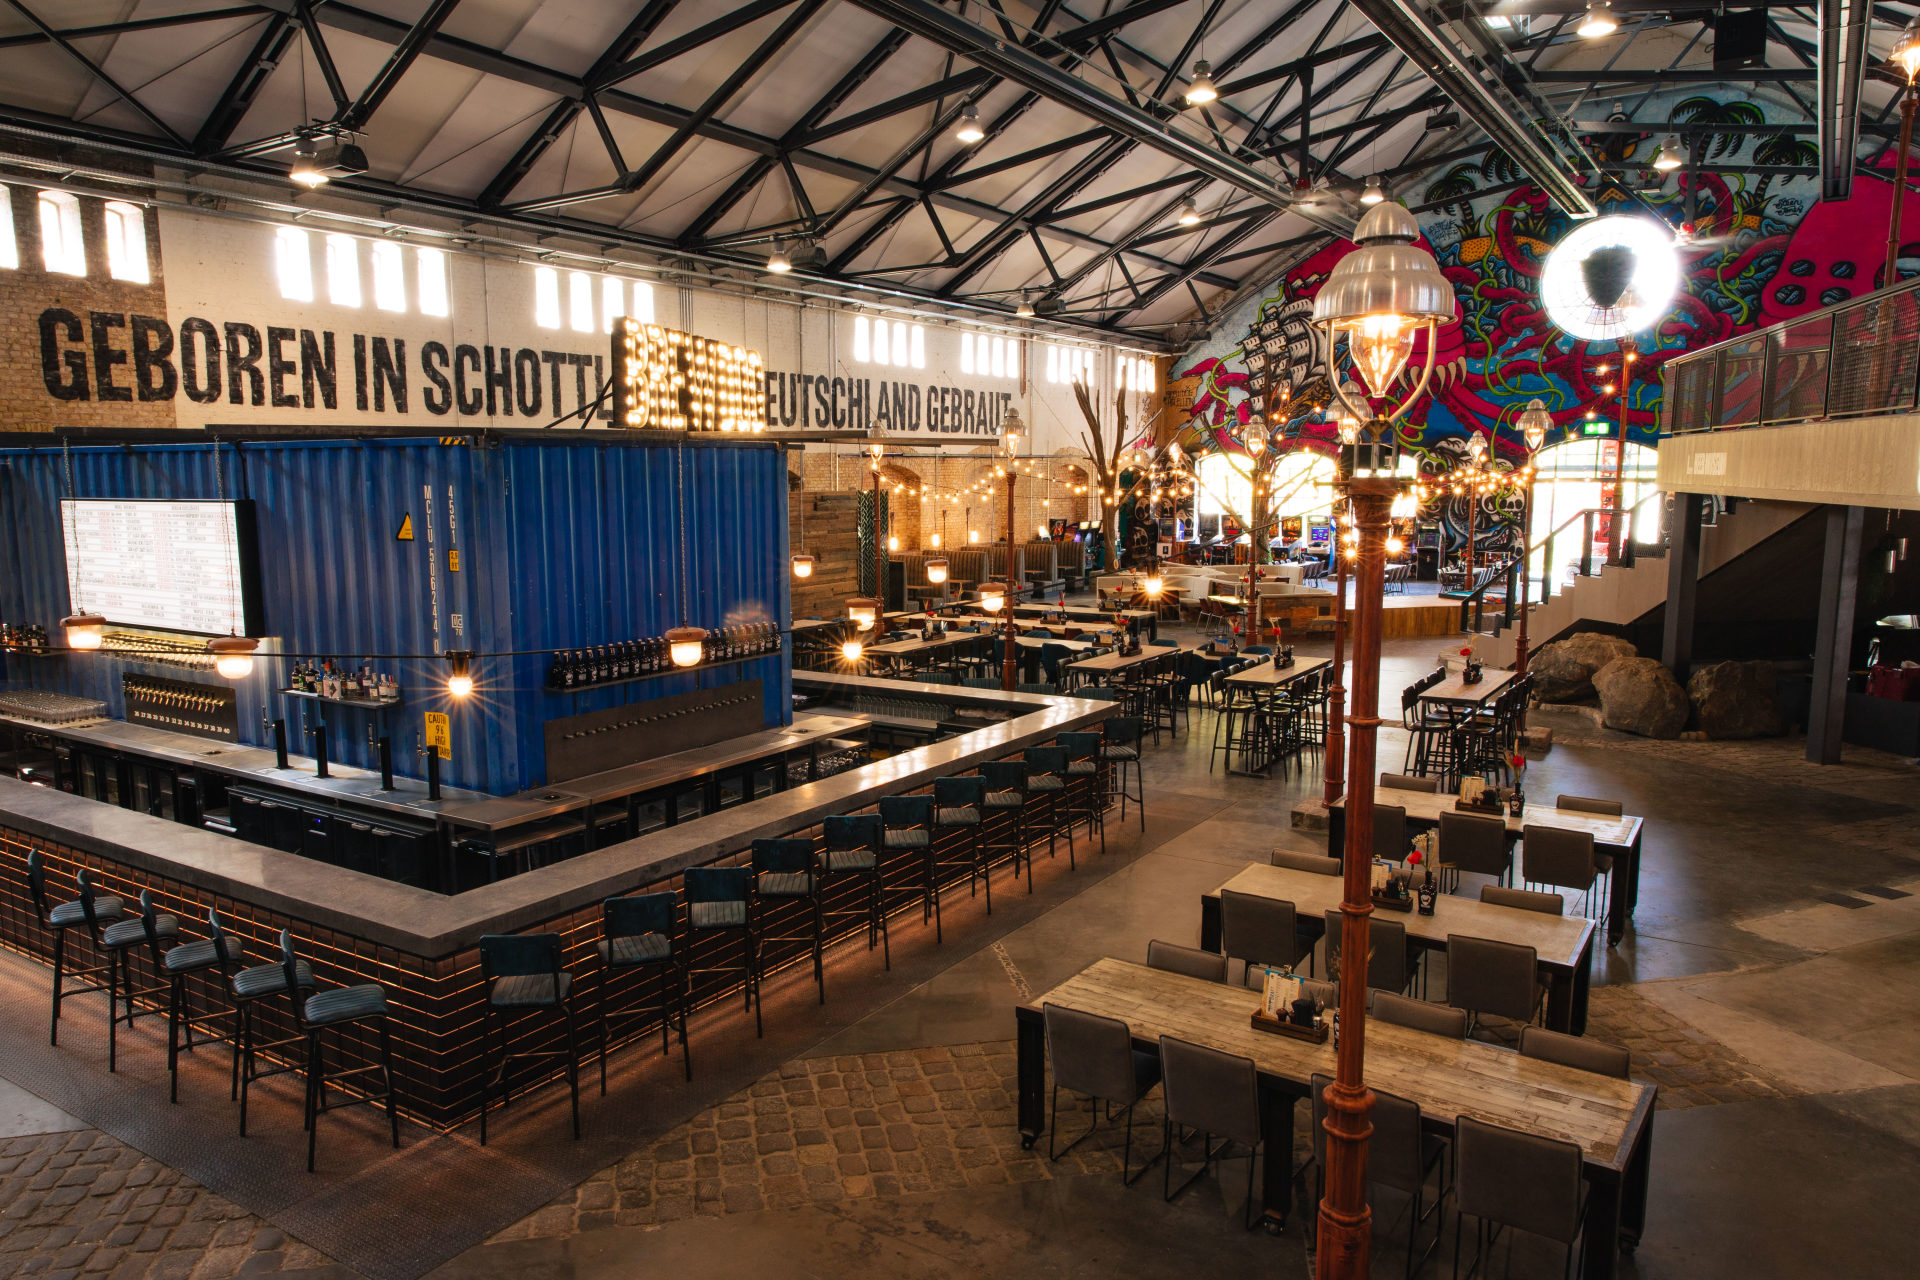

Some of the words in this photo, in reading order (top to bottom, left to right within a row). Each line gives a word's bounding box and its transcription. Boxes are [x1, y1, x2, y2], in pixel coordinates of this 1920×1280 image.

[38, 308, 337, 409] GEBOREN
[353, 333, 409, 414] IN
[421, 340, 615, 421] SCHOTTL
[764, 371, 921, 432] EUTSCHLAND
[926, 384, 1012, 436] GEBRAUT
[613, 315, 767, 433] BREWDOG
[424, 485, 433, 543] MCLU
[429, 547, 438, 633] 506244
